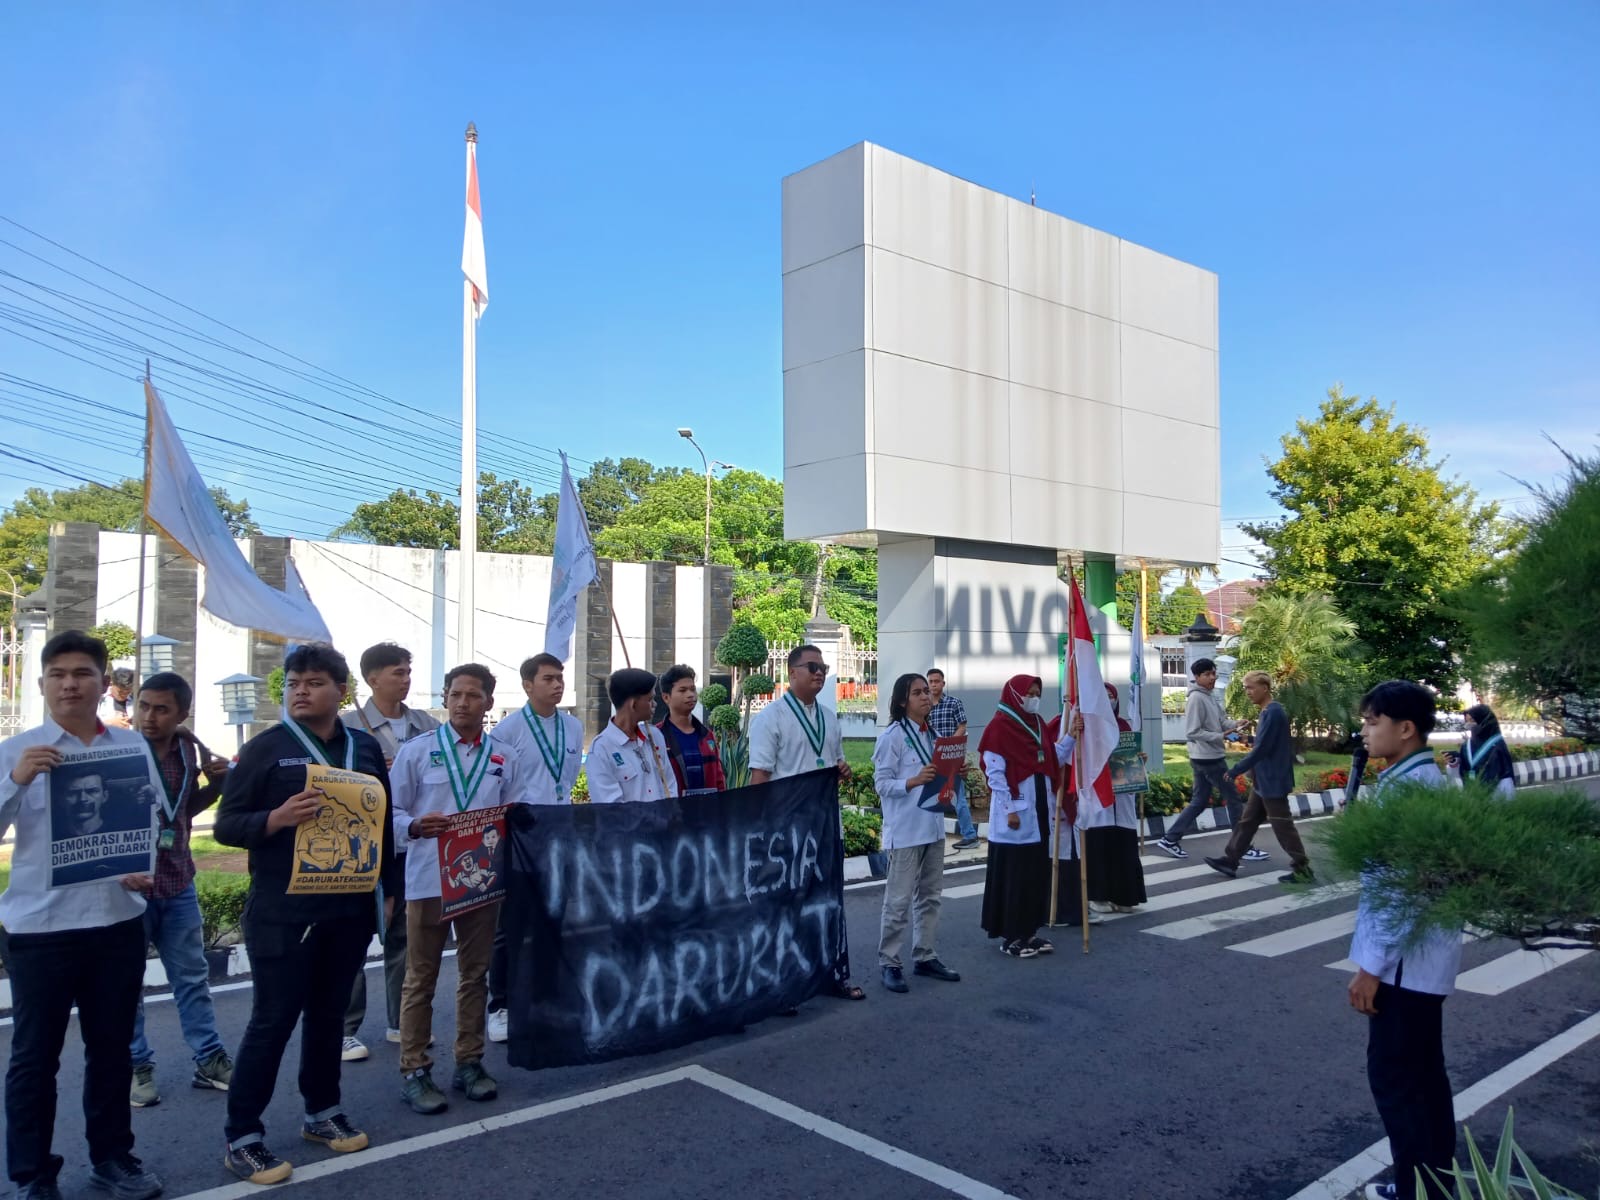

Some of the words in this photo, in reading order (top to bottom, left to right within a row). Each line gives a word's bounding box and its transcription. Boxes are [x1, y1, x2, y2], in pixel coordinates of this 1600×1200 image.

[61, 747, 141, 762] ARURATDEMOKRASI
[312, 775, 347, 784] DARURAT
[52, 834, 120, 854] DEMOKRASI
[123, 830, 152, 843] MATI
[457, 828, 474, 838] DAN
[52, 847, 99, 866] DIBANTAI
[102, 842, 151, 856] OLIGARKI
[296, 875, 375, 884] #DARURATEKONOMI
[547, 826, 823, 922] INDONESIA
[583, 899, 841, 1042] DARURAT
